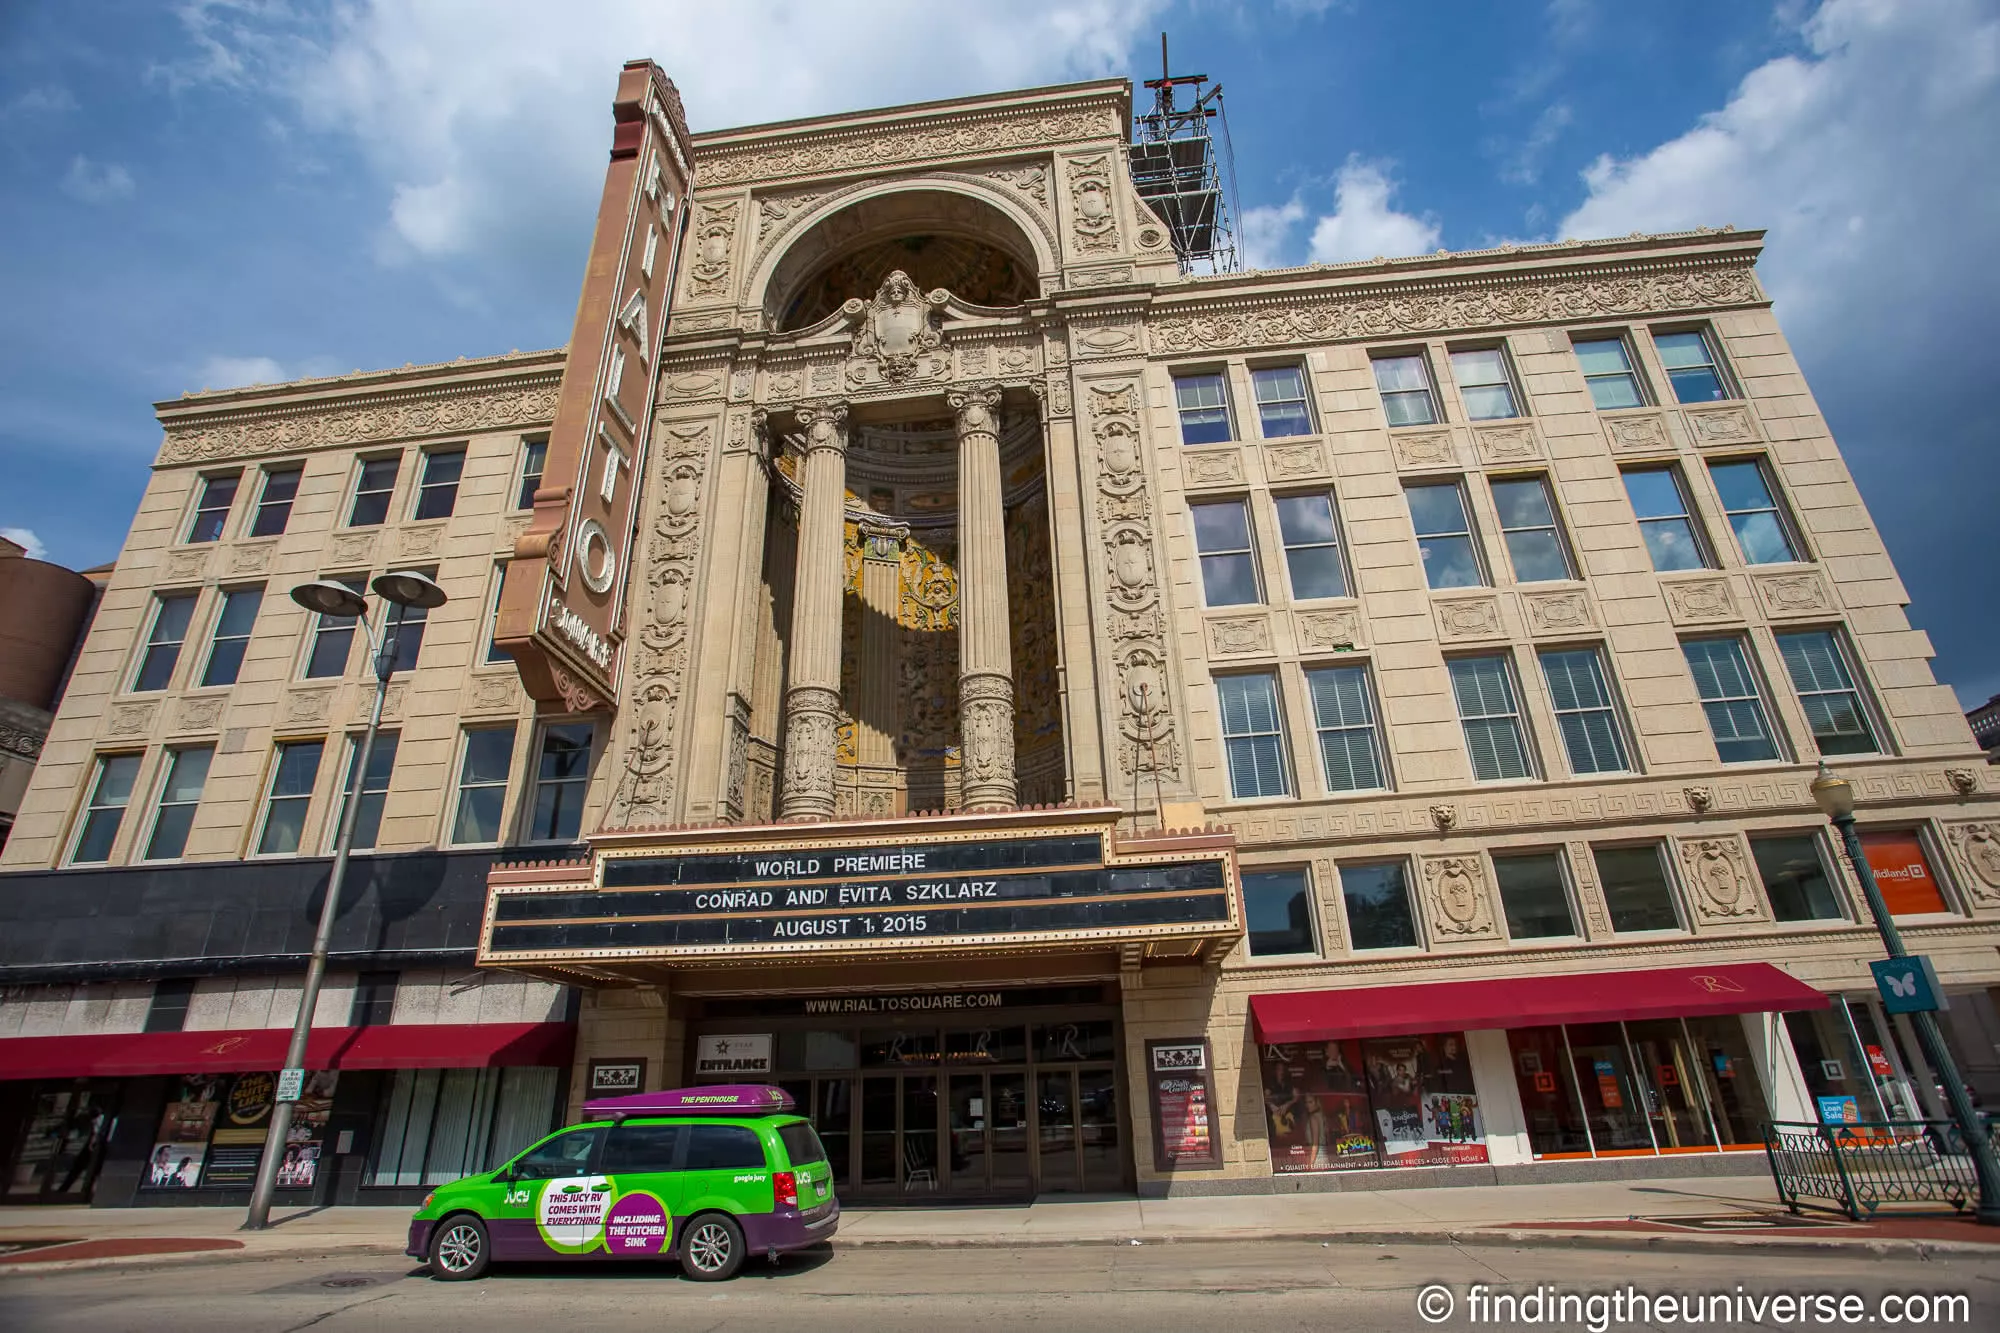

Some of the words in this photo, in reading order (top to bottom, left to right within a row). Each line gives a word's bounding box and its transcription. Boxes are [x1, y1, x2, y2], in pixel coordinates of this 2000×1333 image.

[577, 148, 676, 594] RIALTO
[755, 859, 820, 876] WORLD
[834, 854, 926, 872] PREMIERE
[695, 891, 773, 909] CONRAD
[785, 889, 825, 905] AND
[838, 886, 892, 903] EVITA
[906, 881, 997, 900] SZKLARZ
[773, 918, 850, 937] AUGUST
[863, 918, 875, 933] 1,
[883, 915, 927, 933] 2015
[805, 993, 1001, 1013] WWW.RIALTOSQUARE.COM
[700, 1058, 768, 1071] ENTRANCE
[681, 1096, 695, 1104] THE
[695, 1095, 740, 1103] PENTHOUSE
[1823, 1104, 1841, 1112] Loan
[1824, 1111, 1843, 1120] Sale
[1285, 1163, 1309, 1171] QUALITY
[1310, 1162, 1356, 1170] ENTERTAINMENT
[1405, 1158, 1425, 1166] PRICES
[1460, 1155, 1479, 1163] HOME
[549, 1194, 568, 1203] THIS
[569, 1193, 590, 1203] JUCY
[590, 1192, 603, 1202] RV
[548, 1205, 578, 1215] COMES
[579, 1204, 602, 1214] WITH
[546, 1216, 602, 1226] EVERYTHING
[613, 1214, 661, 1224] INCLUDING
[609, 1225, 627, 1236] THE
[626, 1225, 665, 1236] KITCHEN
[624, 1237, 647, 1248] SINK
